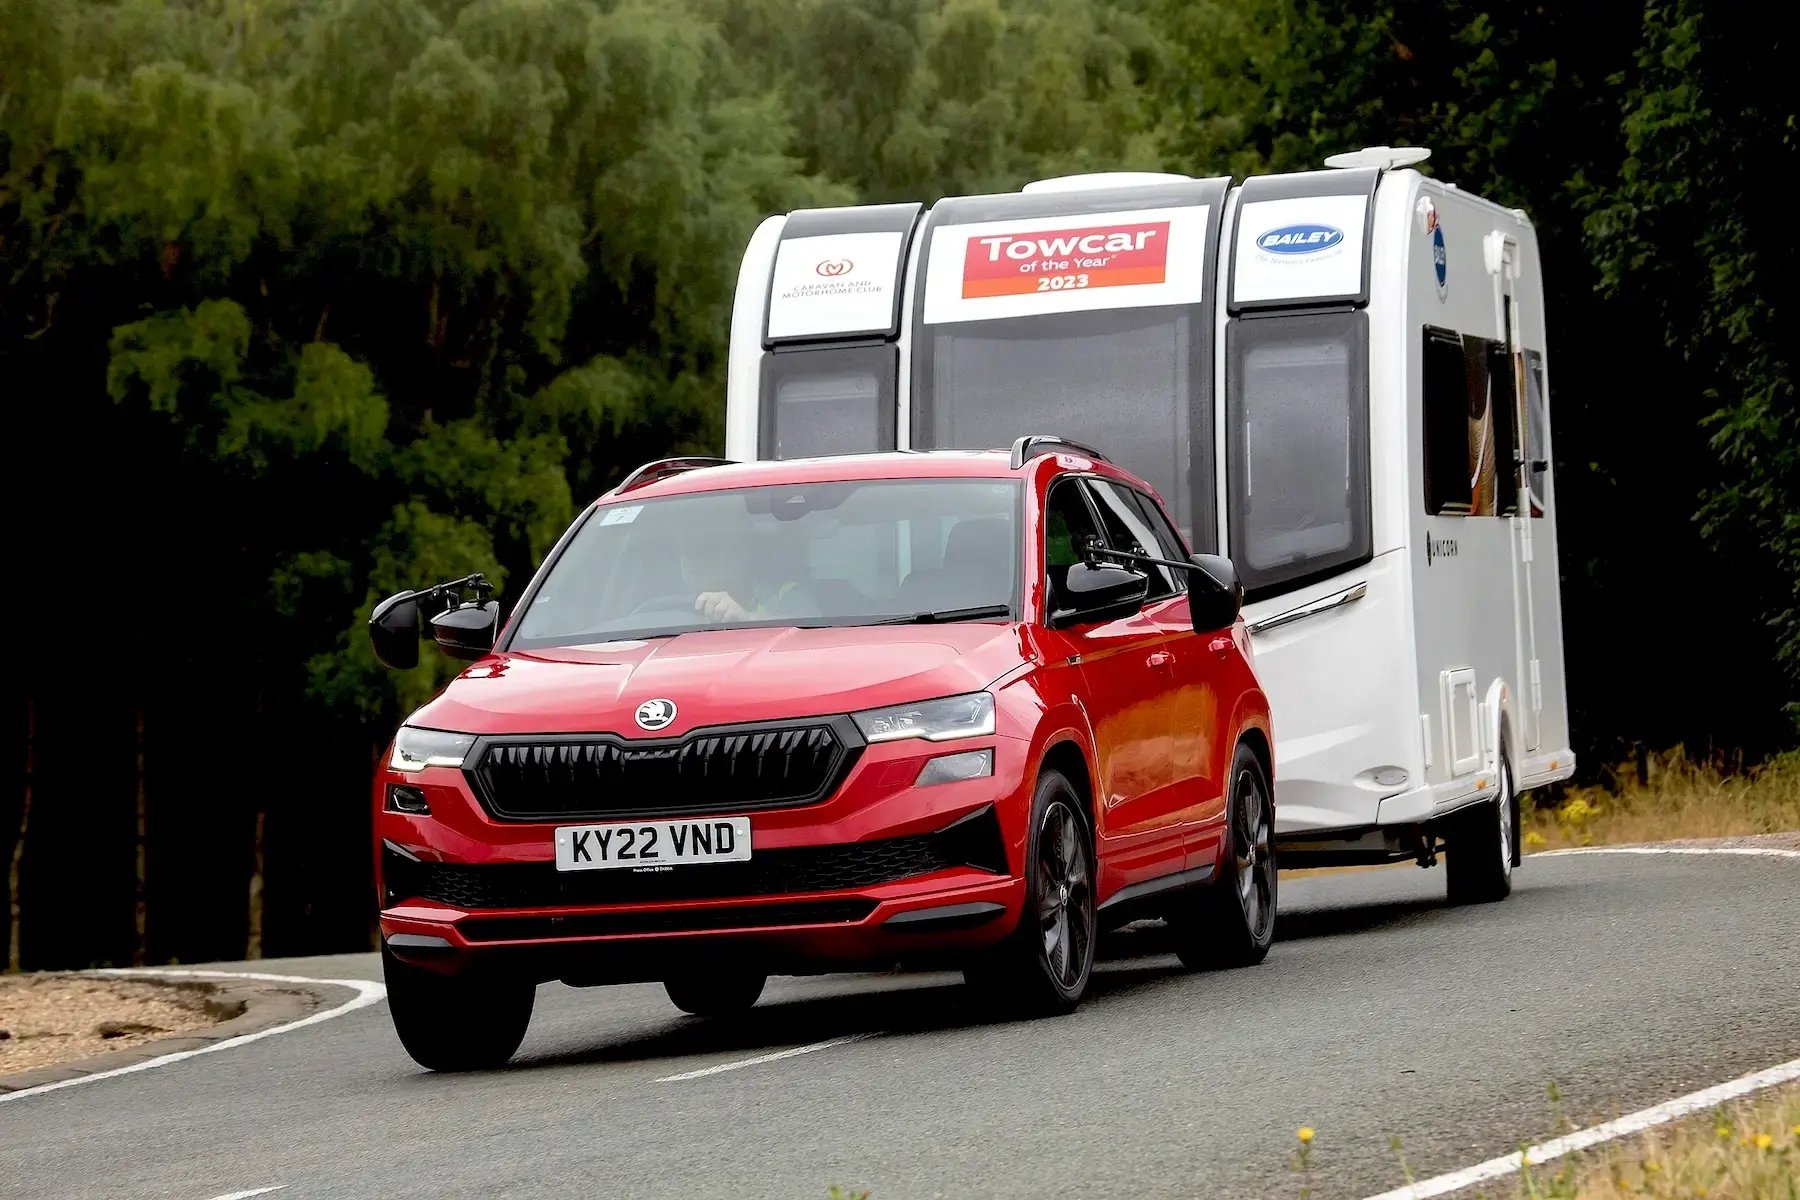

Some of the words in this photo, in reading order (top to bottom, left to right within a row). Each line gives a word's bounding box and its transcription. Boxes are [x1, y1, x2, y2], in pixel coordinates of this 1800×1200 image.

[980, 230, 1157, 262] Towcar
[1262, 231, 1338, 247] BAILEY
[1020, 260, 1038, 273] of
[1042, 258, 1069, 271] the
[1074, 256, 1110, 269] Year
[794, 282, 844, 291] CARAVAN
[1037, 274, 1089, 291] 2023
[782, 287, 853, 299] MOTORHOME
[572, 826, 659, 863] KY22
[669, 822, 735, 857] VND
